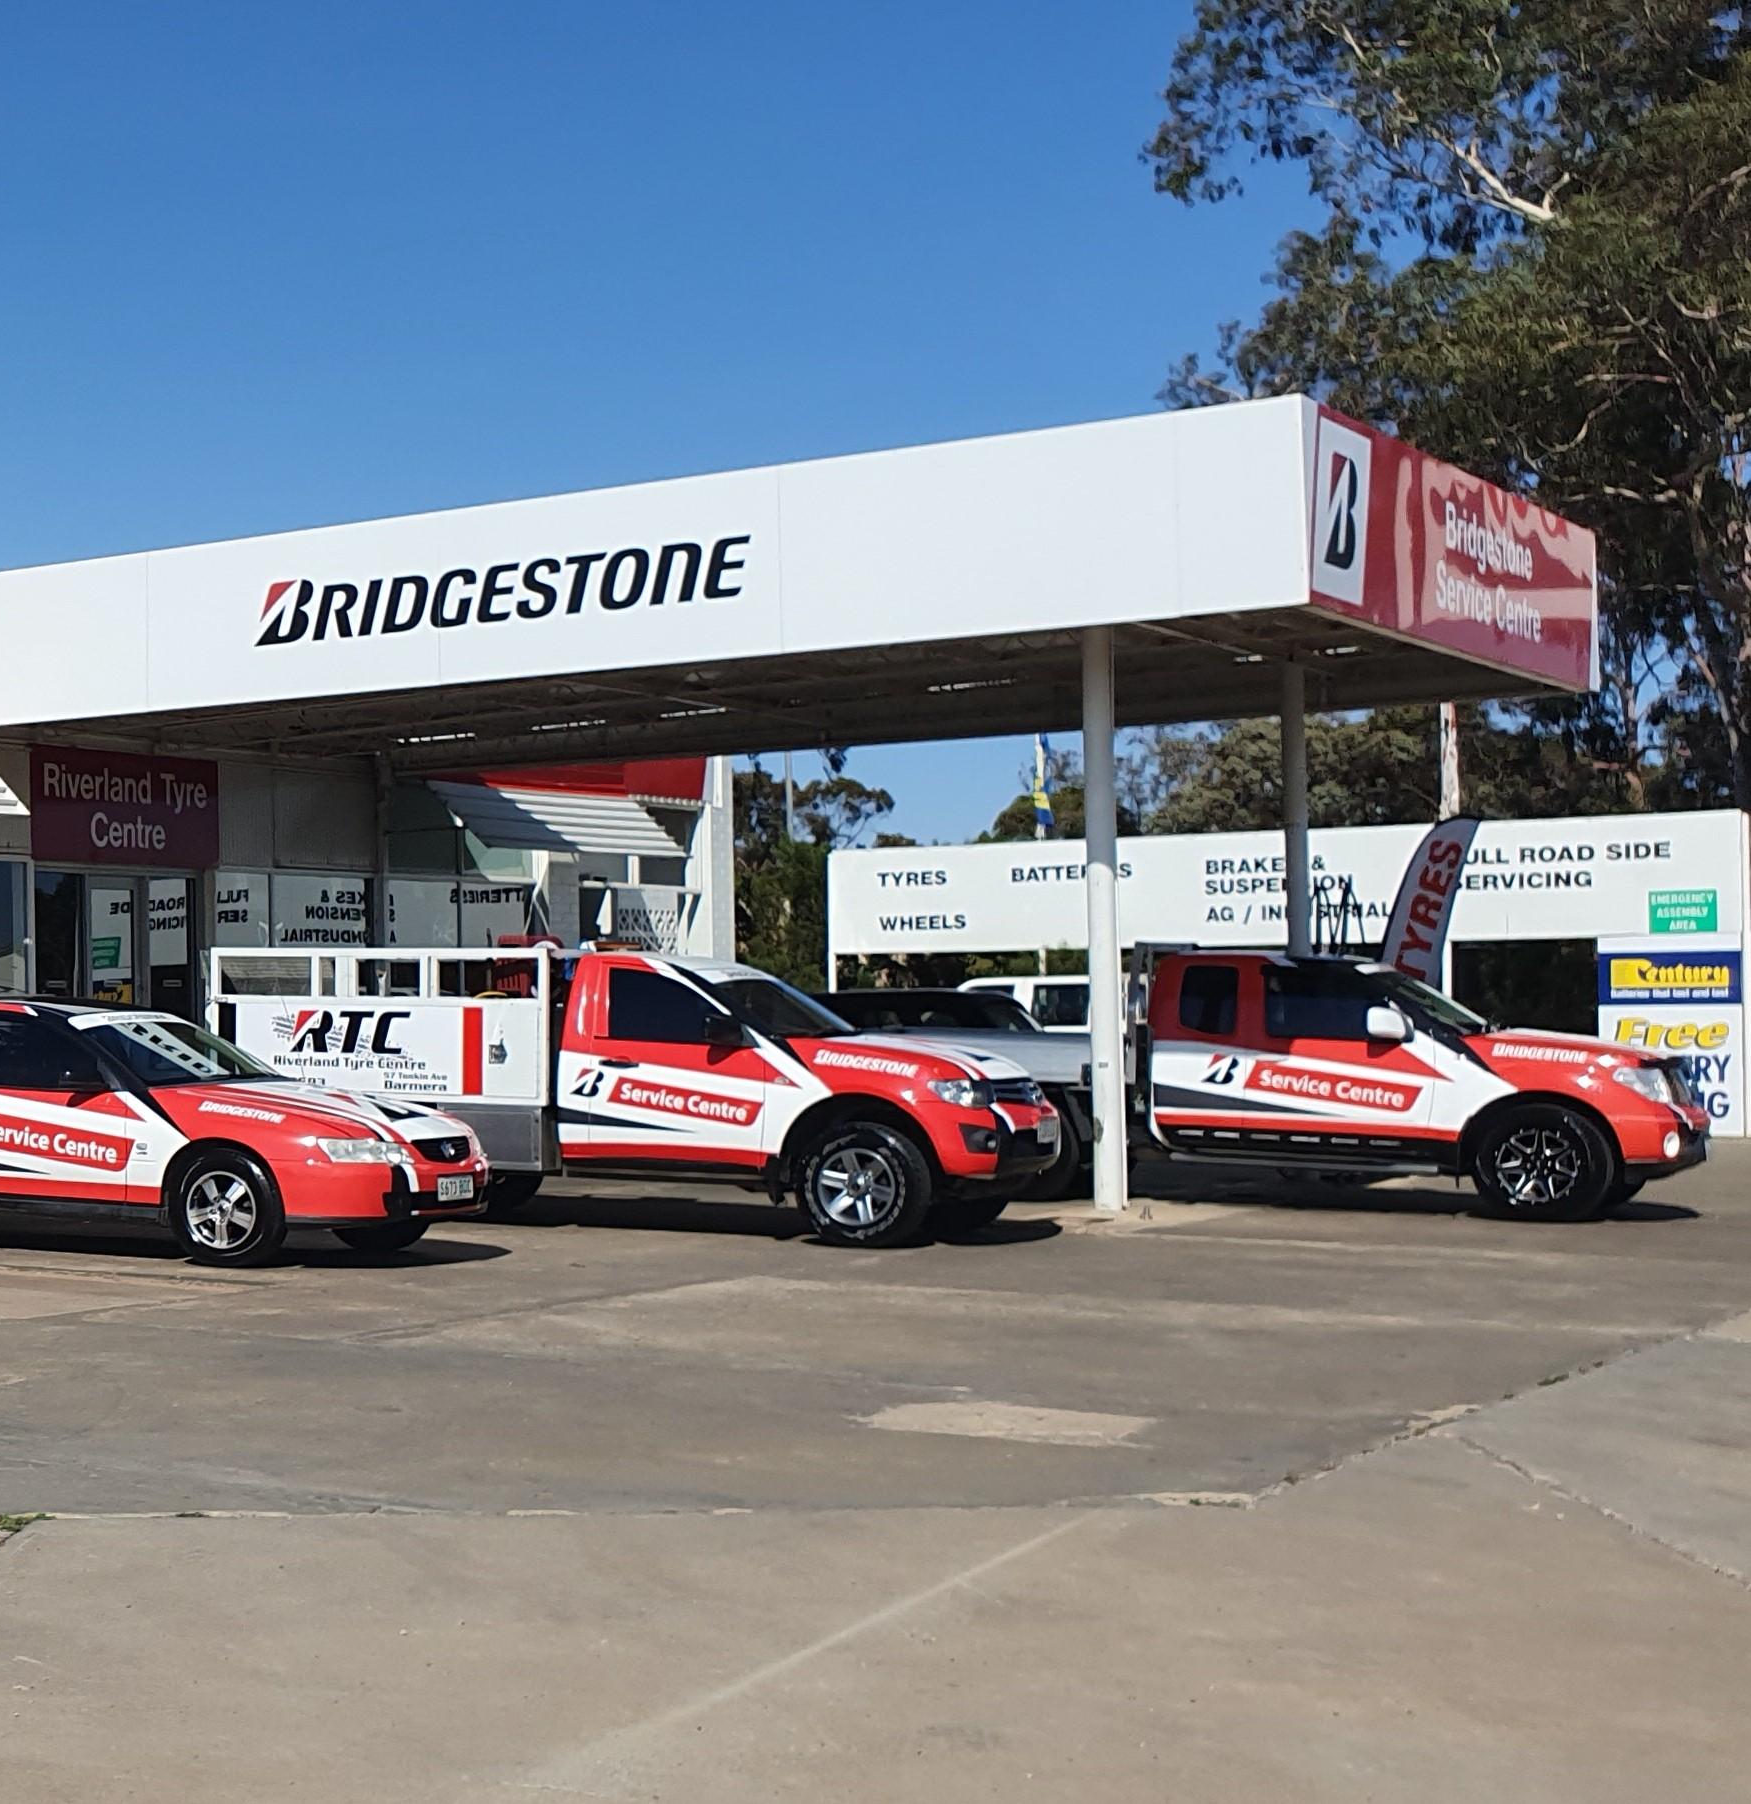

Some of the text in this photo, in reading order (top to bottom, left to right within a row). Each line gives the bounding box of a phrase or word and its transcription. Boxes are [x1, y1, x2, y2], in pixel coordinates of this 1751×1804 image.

[1445, 500, 1534, 582] Bridgestone
[254, 534, 752, 647] BRIDGESTONE
[1436, 560, 1542, 644] Service Centre
[43, 762, 208, 814] Riverland Tyre
[90, 811, 166, 850] Centre
[1205, 855, 1325, 875] BRAKE &
[1464, 841, 1672, 865] ULL ROAD SIDE
[877, 870, 948, 888] TYRES
[1456, 870, 1592, 890] ERVICING
[1395, 839, 1463, 981] TYRES
[1651, 893, 1714, 906] EMERGENCY
[878, 914, 967, 932] WHEELS
[1205, 905, 1234, 923] AG
[1656, 906, 1709, 919] ASSEMBLY
[1669, 919, 1697, 931] AREA
[291, 1010, 411, 1054] RTC
[1615, 1016, 1730, 1050] Free
[274, 1055, 426, 1070] Riverland Tyre Centre
[813, 1049, 919, 1078] BRIDGESTONE
[384, 1080, 448, 1092] Barmera
[430, 1073, 448, 1081] Ave
[1259, 1069, 1331, 1096] Service
[1335, 1081, 1404, 1108] Centre
[199, 1100, 286, 1124] BRIDGESTONE
[619, 1083, 683, 1109] Service
[687, 1095, 747, 1121] Centre
[54, 1134, 118, 1164] Centre
